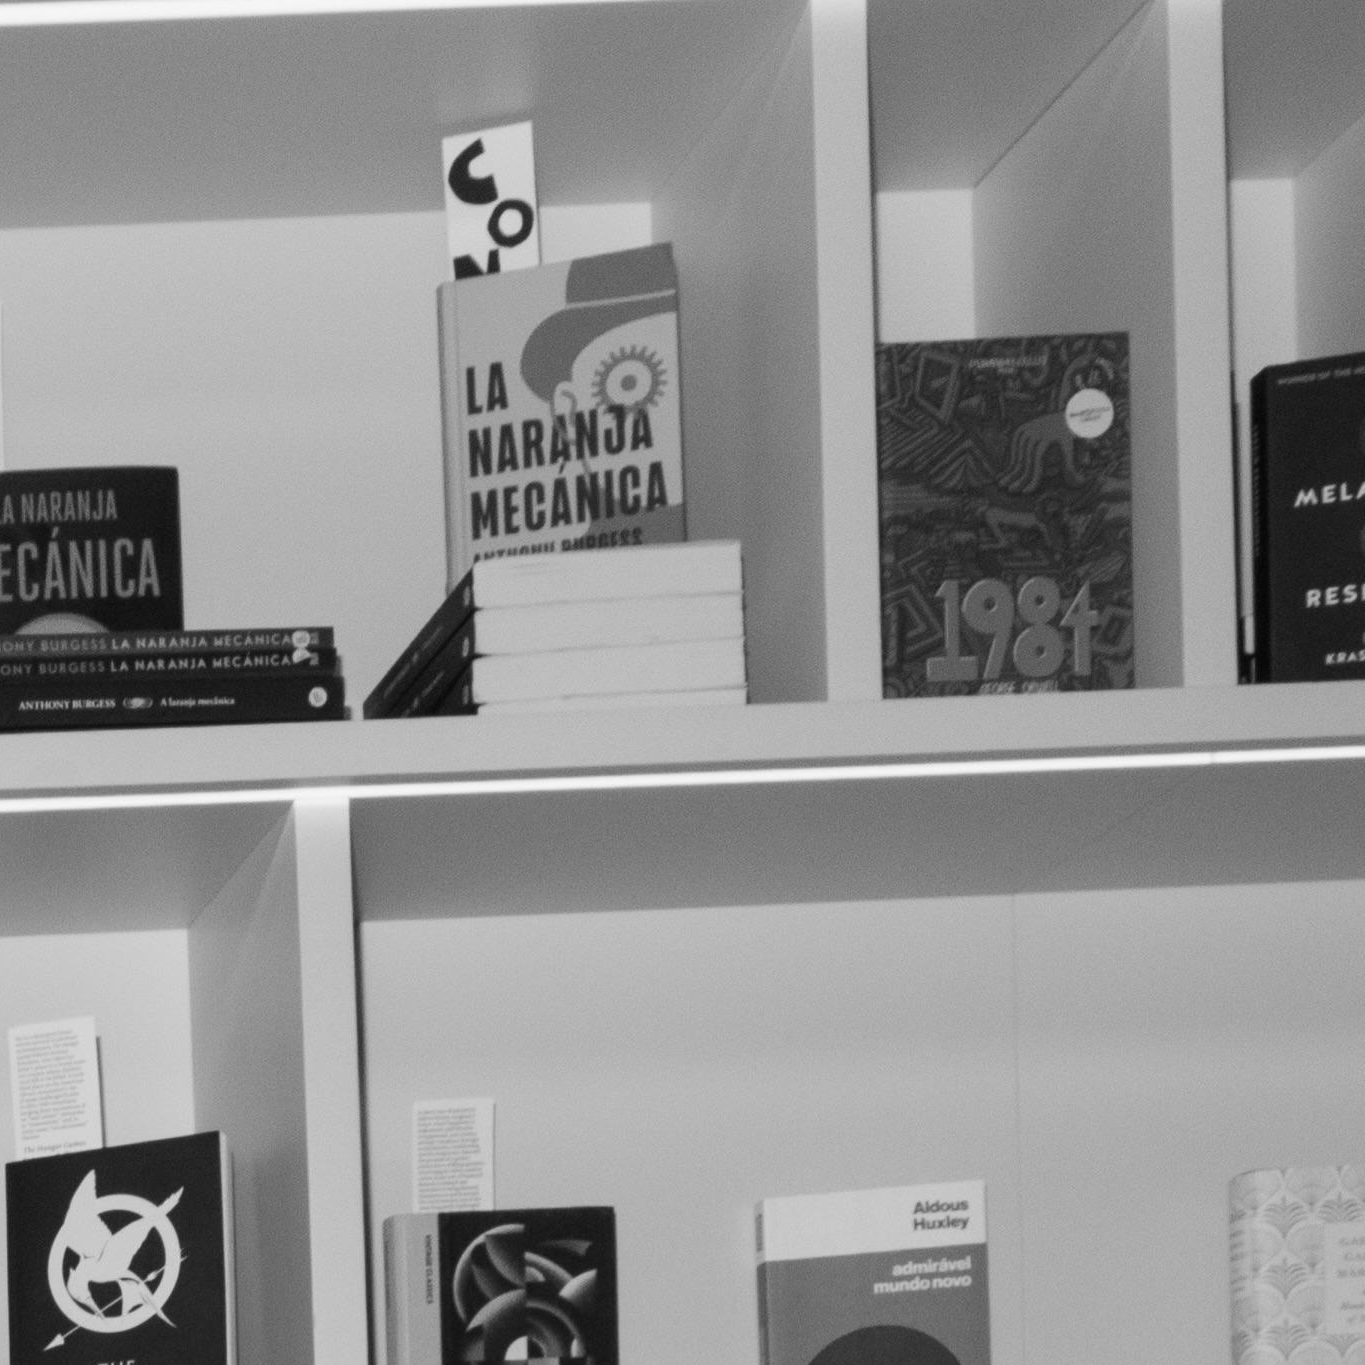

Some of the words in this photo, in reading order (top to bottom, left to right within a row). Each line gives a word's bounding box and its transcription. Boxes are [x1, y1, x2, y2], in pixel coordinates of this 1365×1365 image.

[466, 362, 509, 415] LA
[469, 404, 653, 478] NARANJA
[21, 490, 117, 523] NARANJA
[471, 461, 668, 540] MECÁNICA
[926, 576, 1099, 682] 1984
[912, 1215, 969, 1232] Huxley
[914, 1199, 969, 1215] Aldous
[892, 1256, 972, 1277] admirável
[873, 1276, 931, 1294] mundo
[931, 1275, 972, 1289] novo
